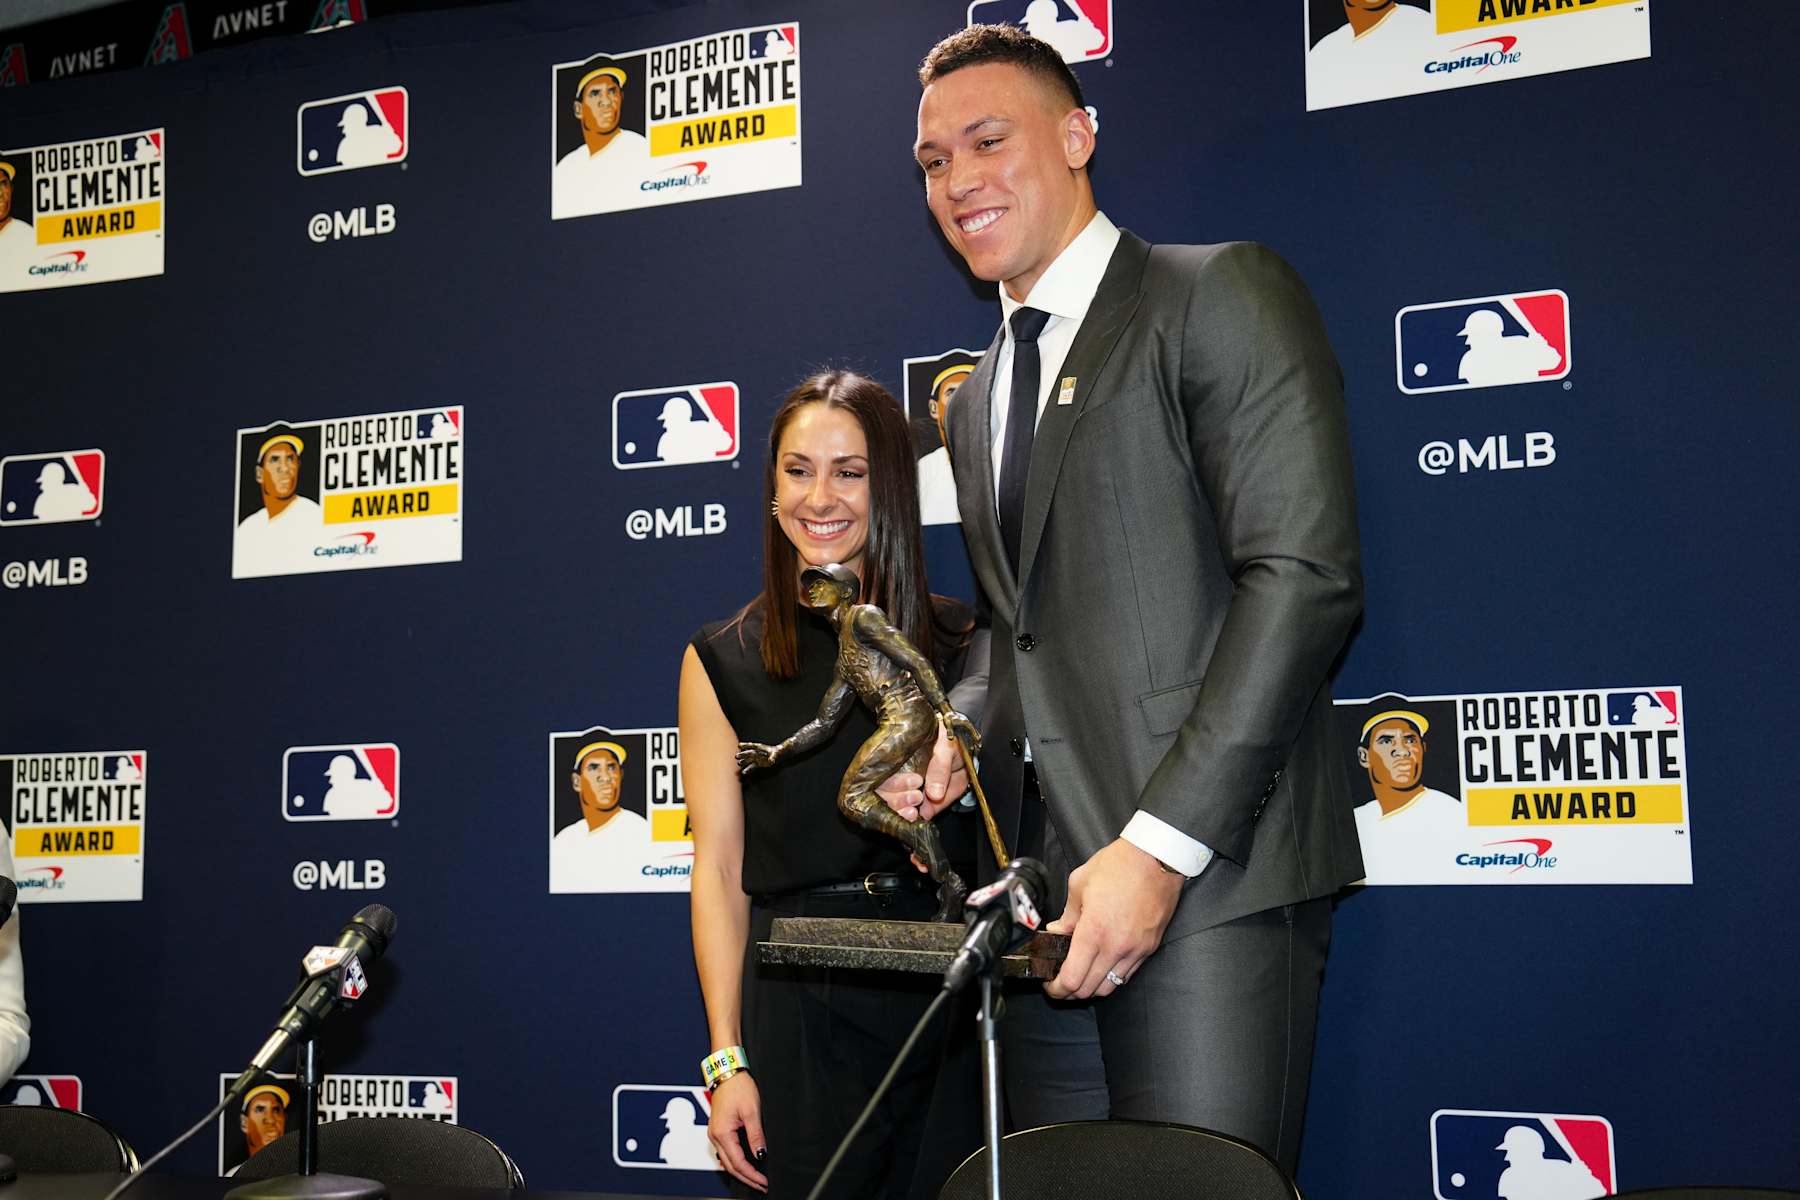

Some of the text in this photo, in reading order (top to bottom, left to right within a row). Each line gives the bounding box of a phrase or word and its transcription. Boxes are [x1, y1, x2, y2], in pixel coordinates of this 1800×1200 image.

[213, 1, 288, 39] AVNET
[49, 43, 118, 79] AVNET
[650, 34, 744, 78] ROBERTO
[650, 60, 796, 121] CLEMENTE
[680, 114, 765, 148] AWARD
[35, 140, 117, 174] ROBERTO
[35, 161, 161, 213] CLEMENTE
[62, 210, 135, 239] AWARD
[308, 203, 396, 243] @MLB
[325, 415, 412, 449] ROBERTO
[324, 441, 459, 490] CLEMENTE
[1418, 431, 1556, 476] @MLB
[351, 491, 430, 518] AWARD
[625, 503, 727, 540] @MLB
[2, 557, 88, 589] @MLB
[1463, 694, 1601, 730] ROBERTO
[16, 756, 99, 783] ROBERTO
[1464, 730, 1681, 783] CLEMENTE
[15, 784, 141, 824] CLEMENTE
[1511, 791, 1636, 820] AWARD
[40, 830, 114, 853] AWARD
[292, 859, 386, 891] @MLB
[642, 865, 691, 878] Capital
[705, 1055, 736, 1075] GAME 3
